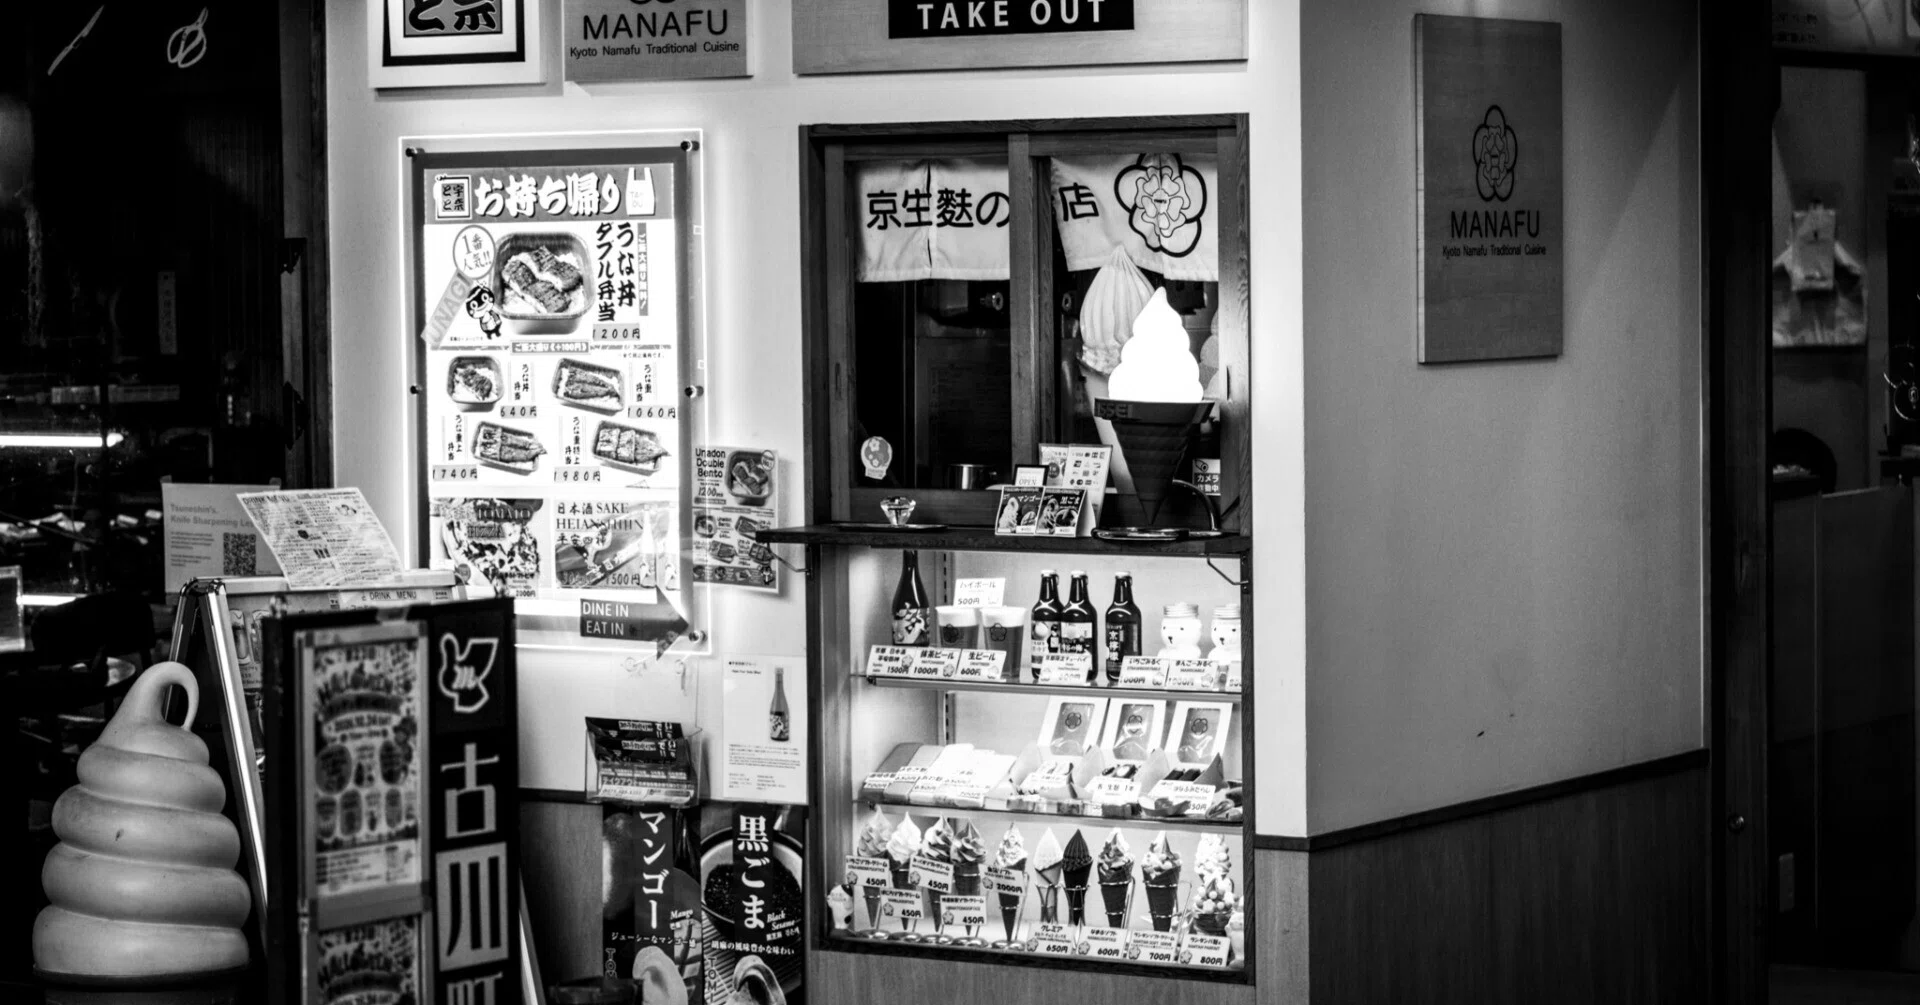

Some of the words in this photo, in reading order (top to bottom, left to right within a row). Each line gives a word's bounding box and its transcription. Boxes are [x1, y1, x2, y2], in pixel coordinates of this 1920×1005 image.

[917, 1, 1009, 30] TAKE
[1030, 0, 1102, 26] OUT
[583, 9, 728, 40] MANAFU
[570, 47, 597, 60] Kyoto
[603, 44, 640, 56] Namafu
[646, 42, 697, 54] Traditional
[703, 40, 739, 53] Cuisine
[474, 172, 621, 217] お持ち帰り
[867, 188, 1010, 230] 京生麩の
[1058, 183, 1100, 222] 店
[1451, 210, 1540, 239] MANAFU
[1442, 245, 1460, 259] Kyoto
[1463, 244, 1487, 256] Namafu
[1490, 244, 1521, 256] Traditional
[1525, 244, 1546, 256] Cuisine
[617, 222, 636, 307] うな丼
[596, 222, 616, 322] ダブル弁当
[592, 328, 640, 340] 1200円
[500, 406, 537, 418] 640円
[628, 407, 676, 418] 1060円
[695, 448, 726, 458] Unadon
[696, 457, 724, 468] Double
[433, 468, 477, 479] 1740円
[554, 471, 600, 482] 1980円
[697, 467, 723, 478] Bento
[1197, 474, 1219, 483] カメラ
[557, 502, 593, 514] 日本酒
[597, 502, 629, 514] SAKE
[170, 515, 191, 524] Knife
[193, 517, 239, 528] Sharpening
[606, 573, 641, 585] 1500円
[370, 592, 391, 600] DRINK
[396, 591, 417, 599] MENU
[582, 602, 612, 616] DINE
[615, 604, 629, 617] IN
[586, 620, 608, 634] EAT
[611, 622, 624, 635] IN
[887, 666, 909, 674] 1500円
[914, 667, 938, 675] 1000円
[961, 668, 981, 676] 600円
[639, 811, 670, 930] マンゴー
[737, 815, 770, 930] 黒ごま
[866, 877, 886, 886] 450円
[928, 880, 949, 892] 450円
[996, 882, 1023, 894] 2000円
[670, 909, 694, 920] Mango
[767, 910, 786, 923] Black
[902, 908, 922, 918] 450円
[771, 920, 795, 931] Sesame
[963, 916, 985, 924] 450円
[1046, 944, 1068, 953] 650円
[1097, 947, 1120, 957] 600円
[1149, 952, 1171, 961] 700円
[1200, 956, 1223, 965] 800円
